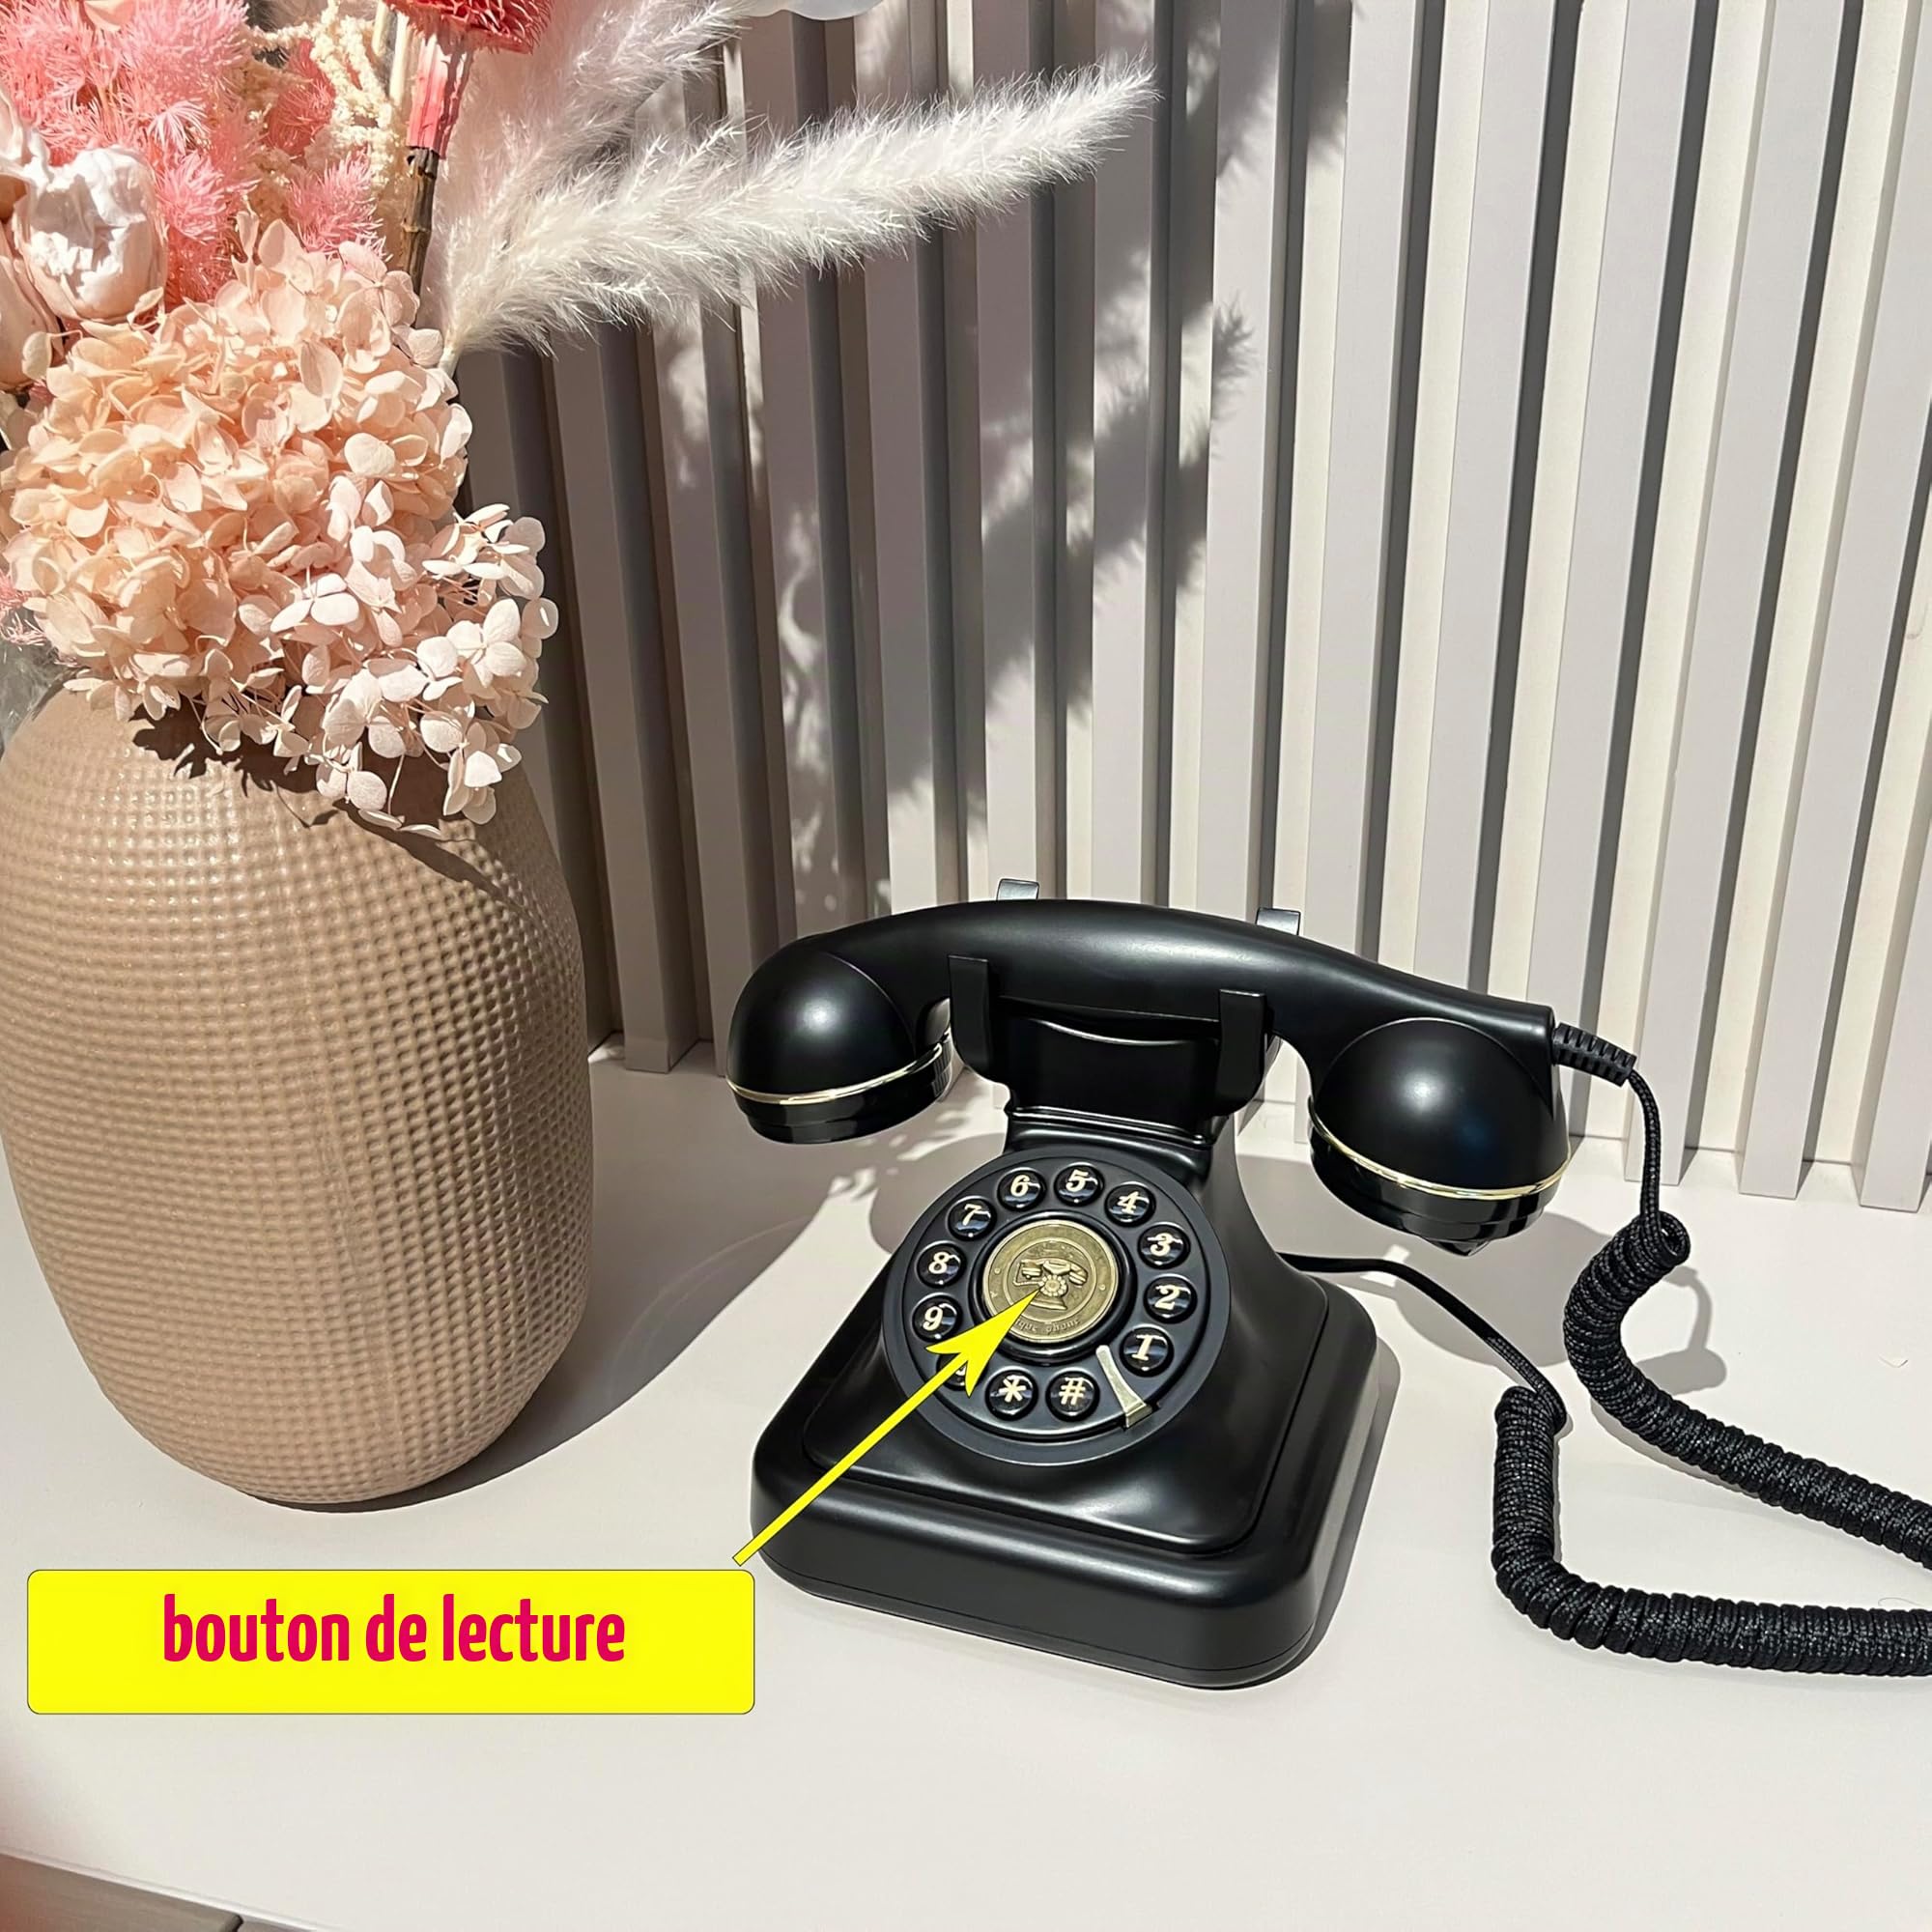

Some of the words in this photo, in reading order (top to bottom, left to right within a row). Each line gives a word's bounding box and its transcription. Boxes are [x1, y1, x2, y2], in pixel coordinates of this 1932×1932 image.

[1010, 1174, 1030, 1198] 6
[1065, 1170, 1087, 1193] 5
[1117, 1190, 1139, 1214] 4
[961, 1204, 980, 1227] 7
[1150, 1233, 1173, 1257] 3
[927, 1251, 949, 1275] 8
[1157, 1285, 1180, 1312] 2
[924, 1305, 944, 1330] 9
[1130, 1336, 1152, 1361] 1
